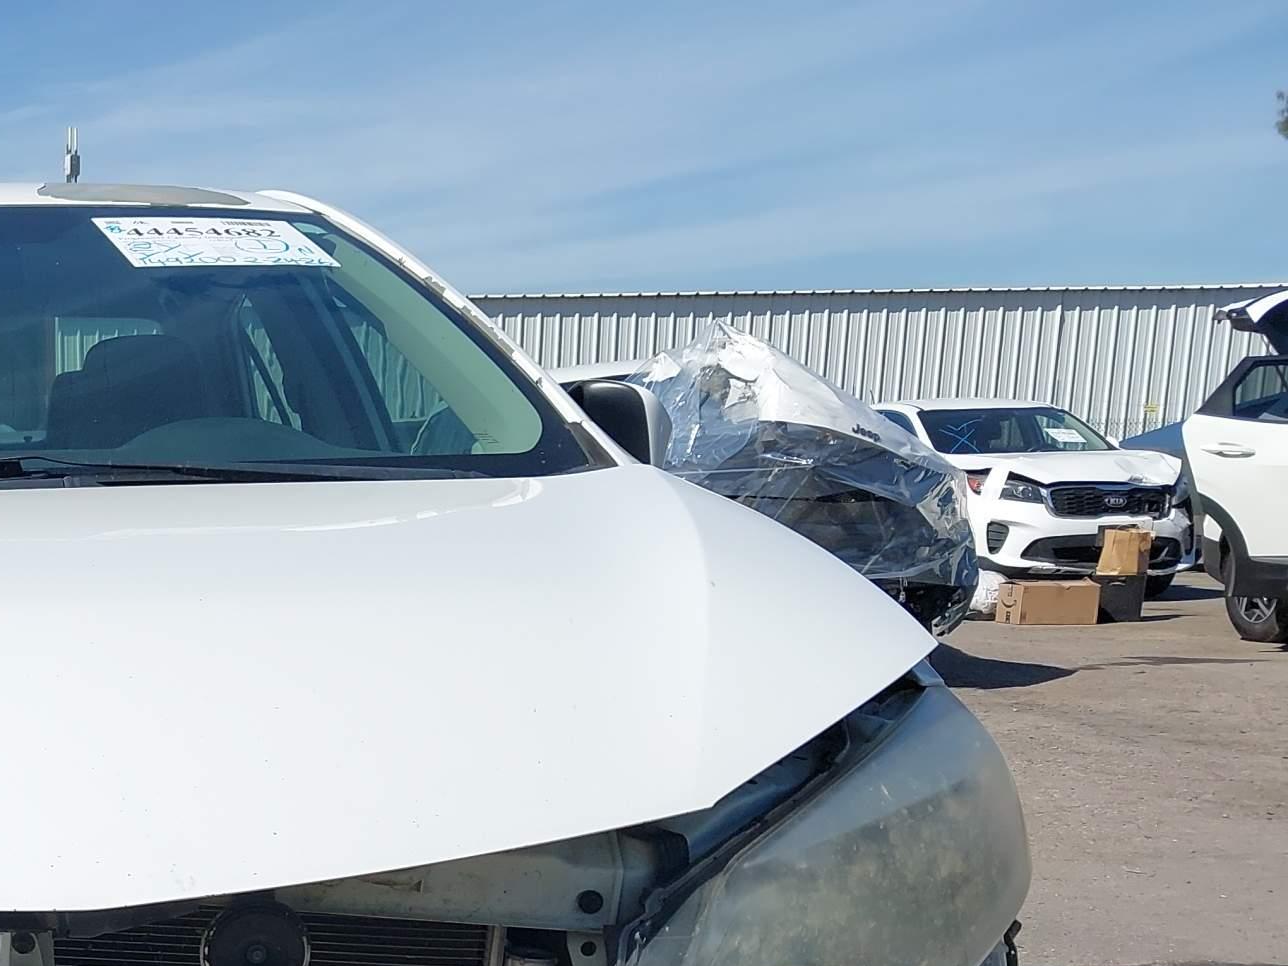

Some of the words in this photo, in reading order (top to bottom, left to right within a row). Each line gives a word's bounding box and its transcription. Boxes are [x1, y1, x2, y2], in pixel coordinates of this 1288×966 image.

[127, 226, 281, 238] 44454682
[852, 424, 881, 442] Jeep
[1109, 497, 1124, 505] KIA
